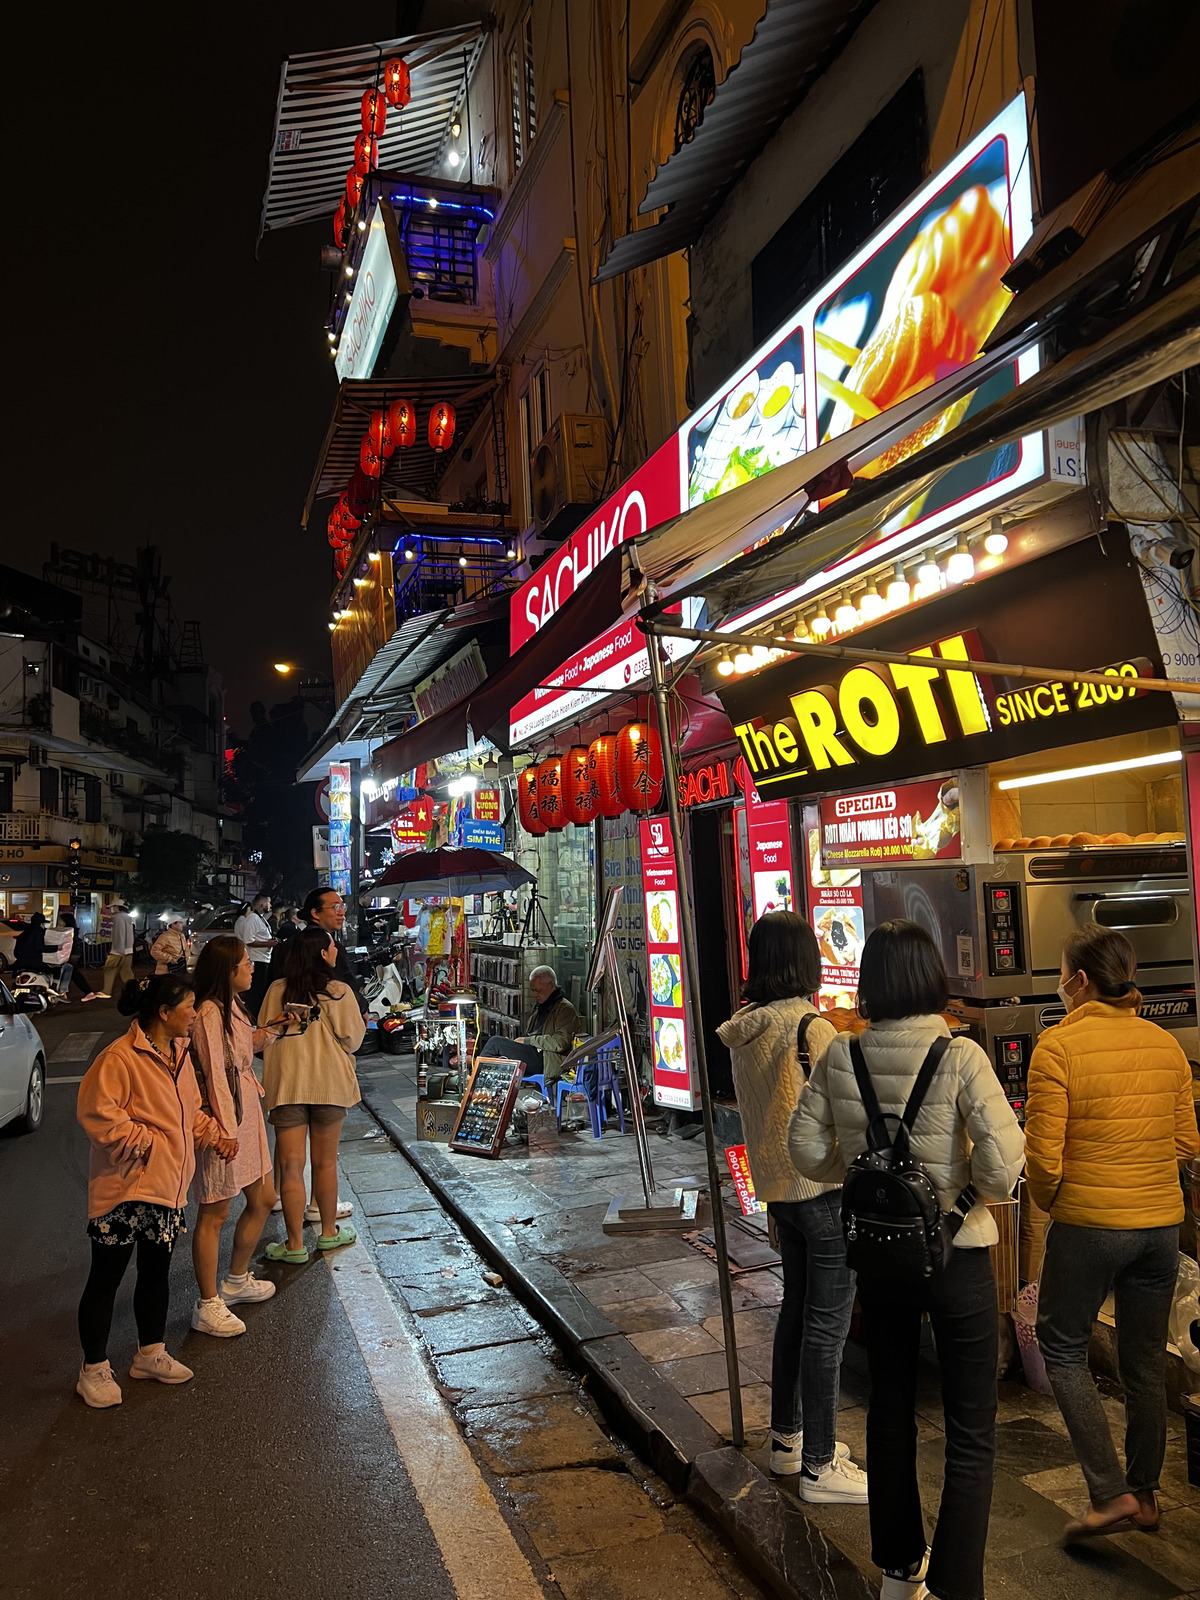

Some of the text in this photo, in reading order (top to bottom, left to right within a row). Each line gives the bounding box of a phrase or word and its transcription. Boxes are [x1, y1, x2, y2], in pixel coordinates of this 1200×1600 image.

[526, 490, 647, 632] SACHIKO
[564, 661, 578, 682] Food
[583, 642, 614, 671] Japanese
[614, 627, 631, 652] Food
[734, 722, 799, 773] The
[789, 634, 989, 771] ROTI
[996, 681, 1069, 726] SINCE
[1074, 663, 1140, 709] 2009
[838, 794, 893, 814] SPECIAL
[466, 835, 483, 844] SIM
[756, 840, 783, 852] Japanese
[764, 853, 777, 863] Food
[654, 878, 666, 886] Food
[1136, 1001, 1189, 1017] UTHSTAR
[728, 1150, 741, 1170] 090
[735, 1170, 746, 1190] 412
